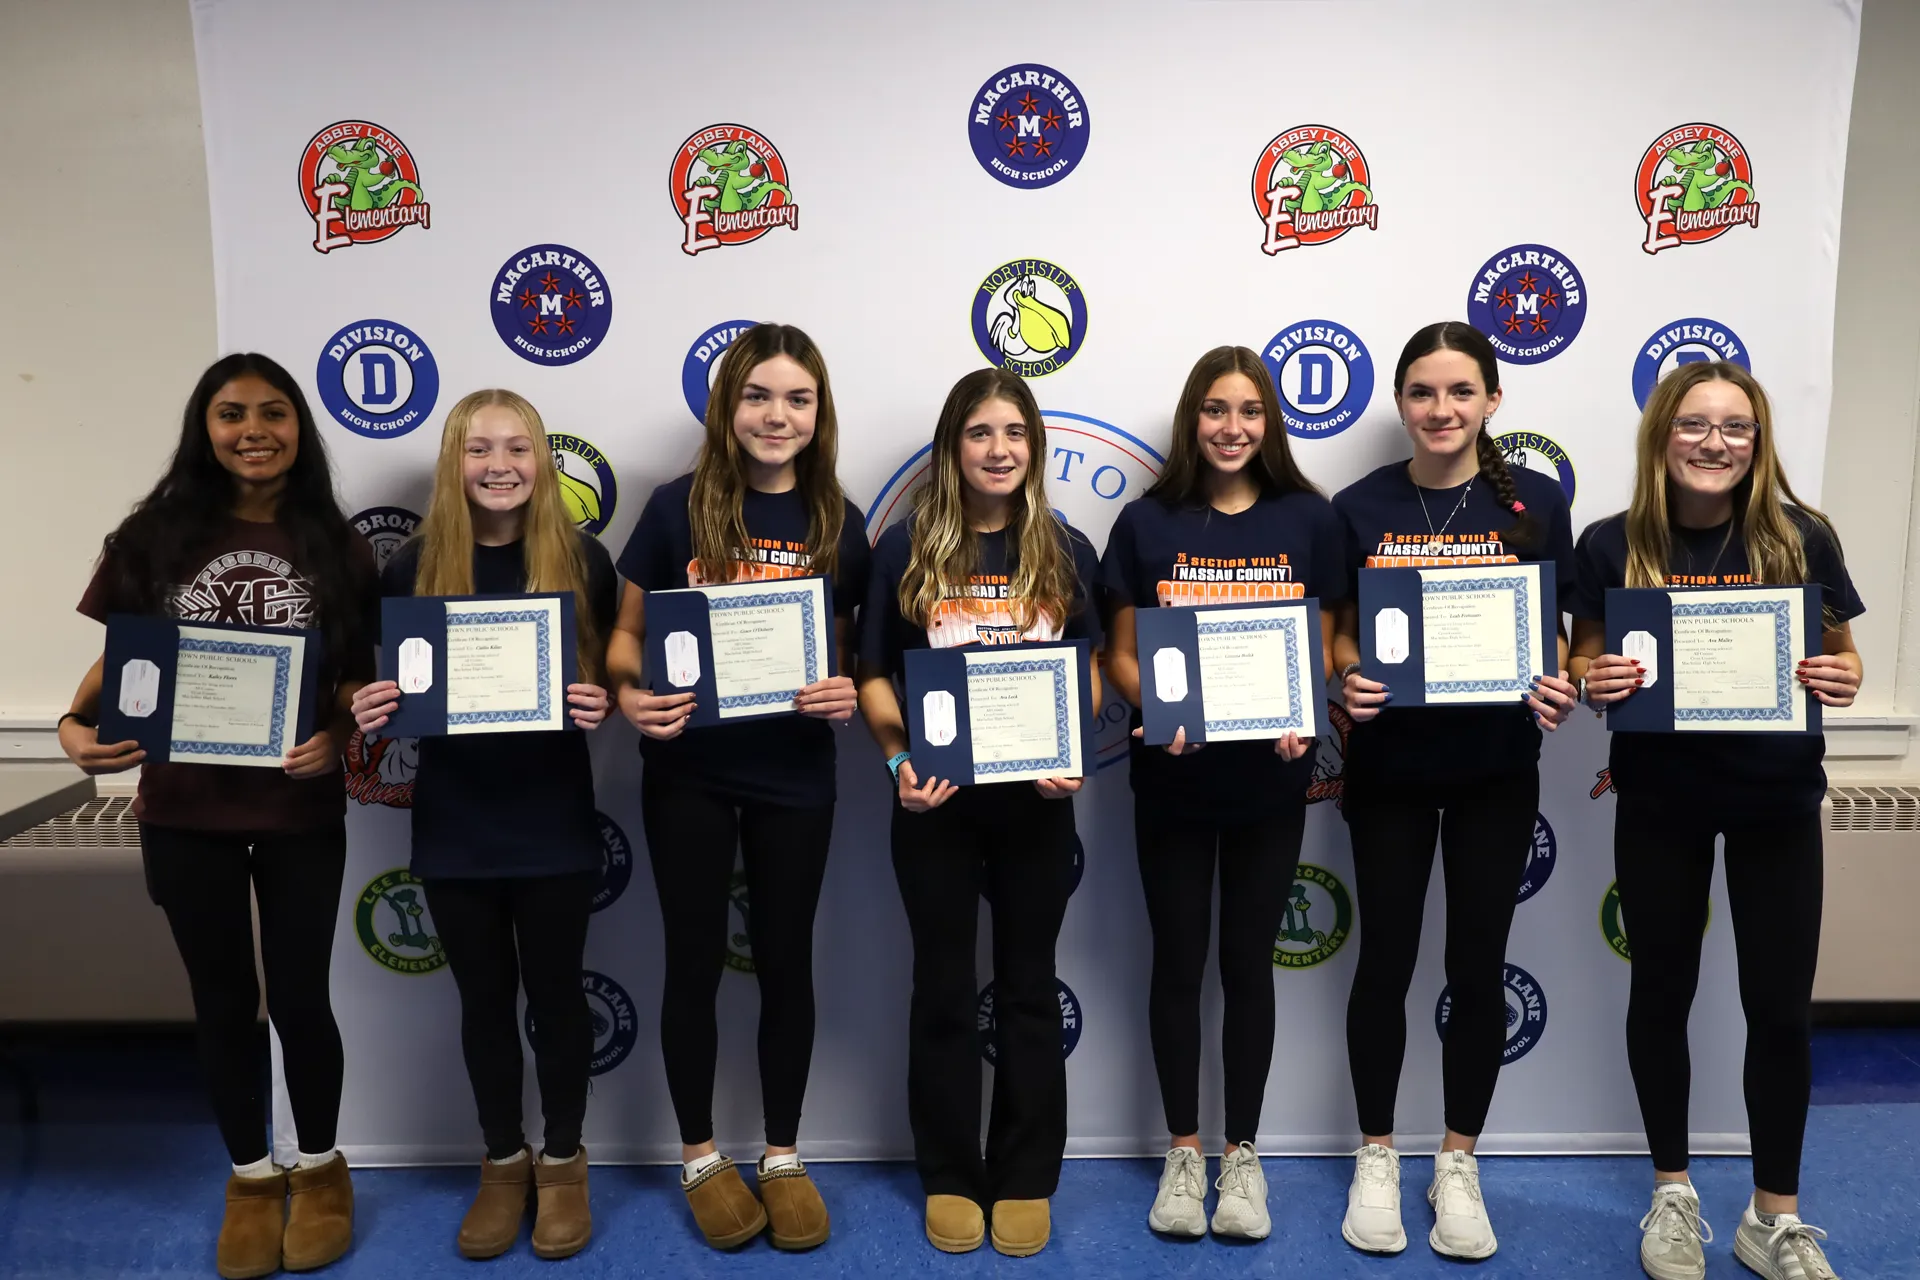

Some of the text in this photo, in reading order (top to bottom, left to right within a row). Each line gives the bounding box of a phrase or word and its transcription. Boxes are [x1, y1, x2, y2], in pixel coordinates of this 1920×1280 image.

[974, 70, 1083, 129] MACARTHUR
[314, 125, 405, 160] ABBEY LANE
[1016, 115, 1041, 138] M
[686, 128, 775, 161] ABBEY LANE
[1270, 129, 1358, 162] ABBEY LANE
[1654, 127, 1741, 160] ABBEY LANE
[990, 156, 1068, 181] HIGH SCHOOL
[313, 181, 430, 253] Elementary
[682, 185, 798, 256] Elementary
[1262, 185, 1379, 256] Elementary
[1642, 184, 1760, 255] Elementary
[496, 250, 605, 308] MACARTHUR
[981, 260, 1078, 296] NORTHSIDE
[1474, 250, 1580, 307] MACARTHUR
[539, 293, 564, 316] M
[1515, 293, 1540, 315] M
[328, 326, 425, 362] DIVISION
[513, 334, 593, 358] HIGH SCHOOL
[1268, 327, 1362, 363] DIVISION
[1487, 333, 1564, 357] HIGH SCHOOL
[1646, 325, 1739, 361] DIVISION
[359, 353, 398, 405] D
[1001, 356, 1065, 377] SCHOOL
[1297, 353, 1334, 405] D
[340, 408, 419, 432] HIGH SCHOOL
[1306, 409, 1352, 431] SCHOOL
[551, 435, 605, 469] HSIDE
[1494, 434, 1566, 466] RTHSIDE
[1384, 543, 1497, 556] NASSA COUNTY
[1396, 534, 1454, 543] SECTION
[1459, 534, 1485, 543] VIII
[1177, 552, 1288, 568] 25 SECTION VIII 26
[1179, 567, 1286, 582] NASSAU COUNTY
[1664, 574, 1717, 585] ECTION
[225, 655, 258, 664] SCHOOLS
[363, 876, 393, 905] LEE
[1273, 929, 1345, 966] EMENTARY
[597, 980, 632, 1032] LANE
[1057, 991, 1076, 1030] ANE
[1510, 973, 1541, 1022] LANE
[590, 1045, 624, 1069] CHOOL
[1503, 1036, 1531, 1058] HOOL
